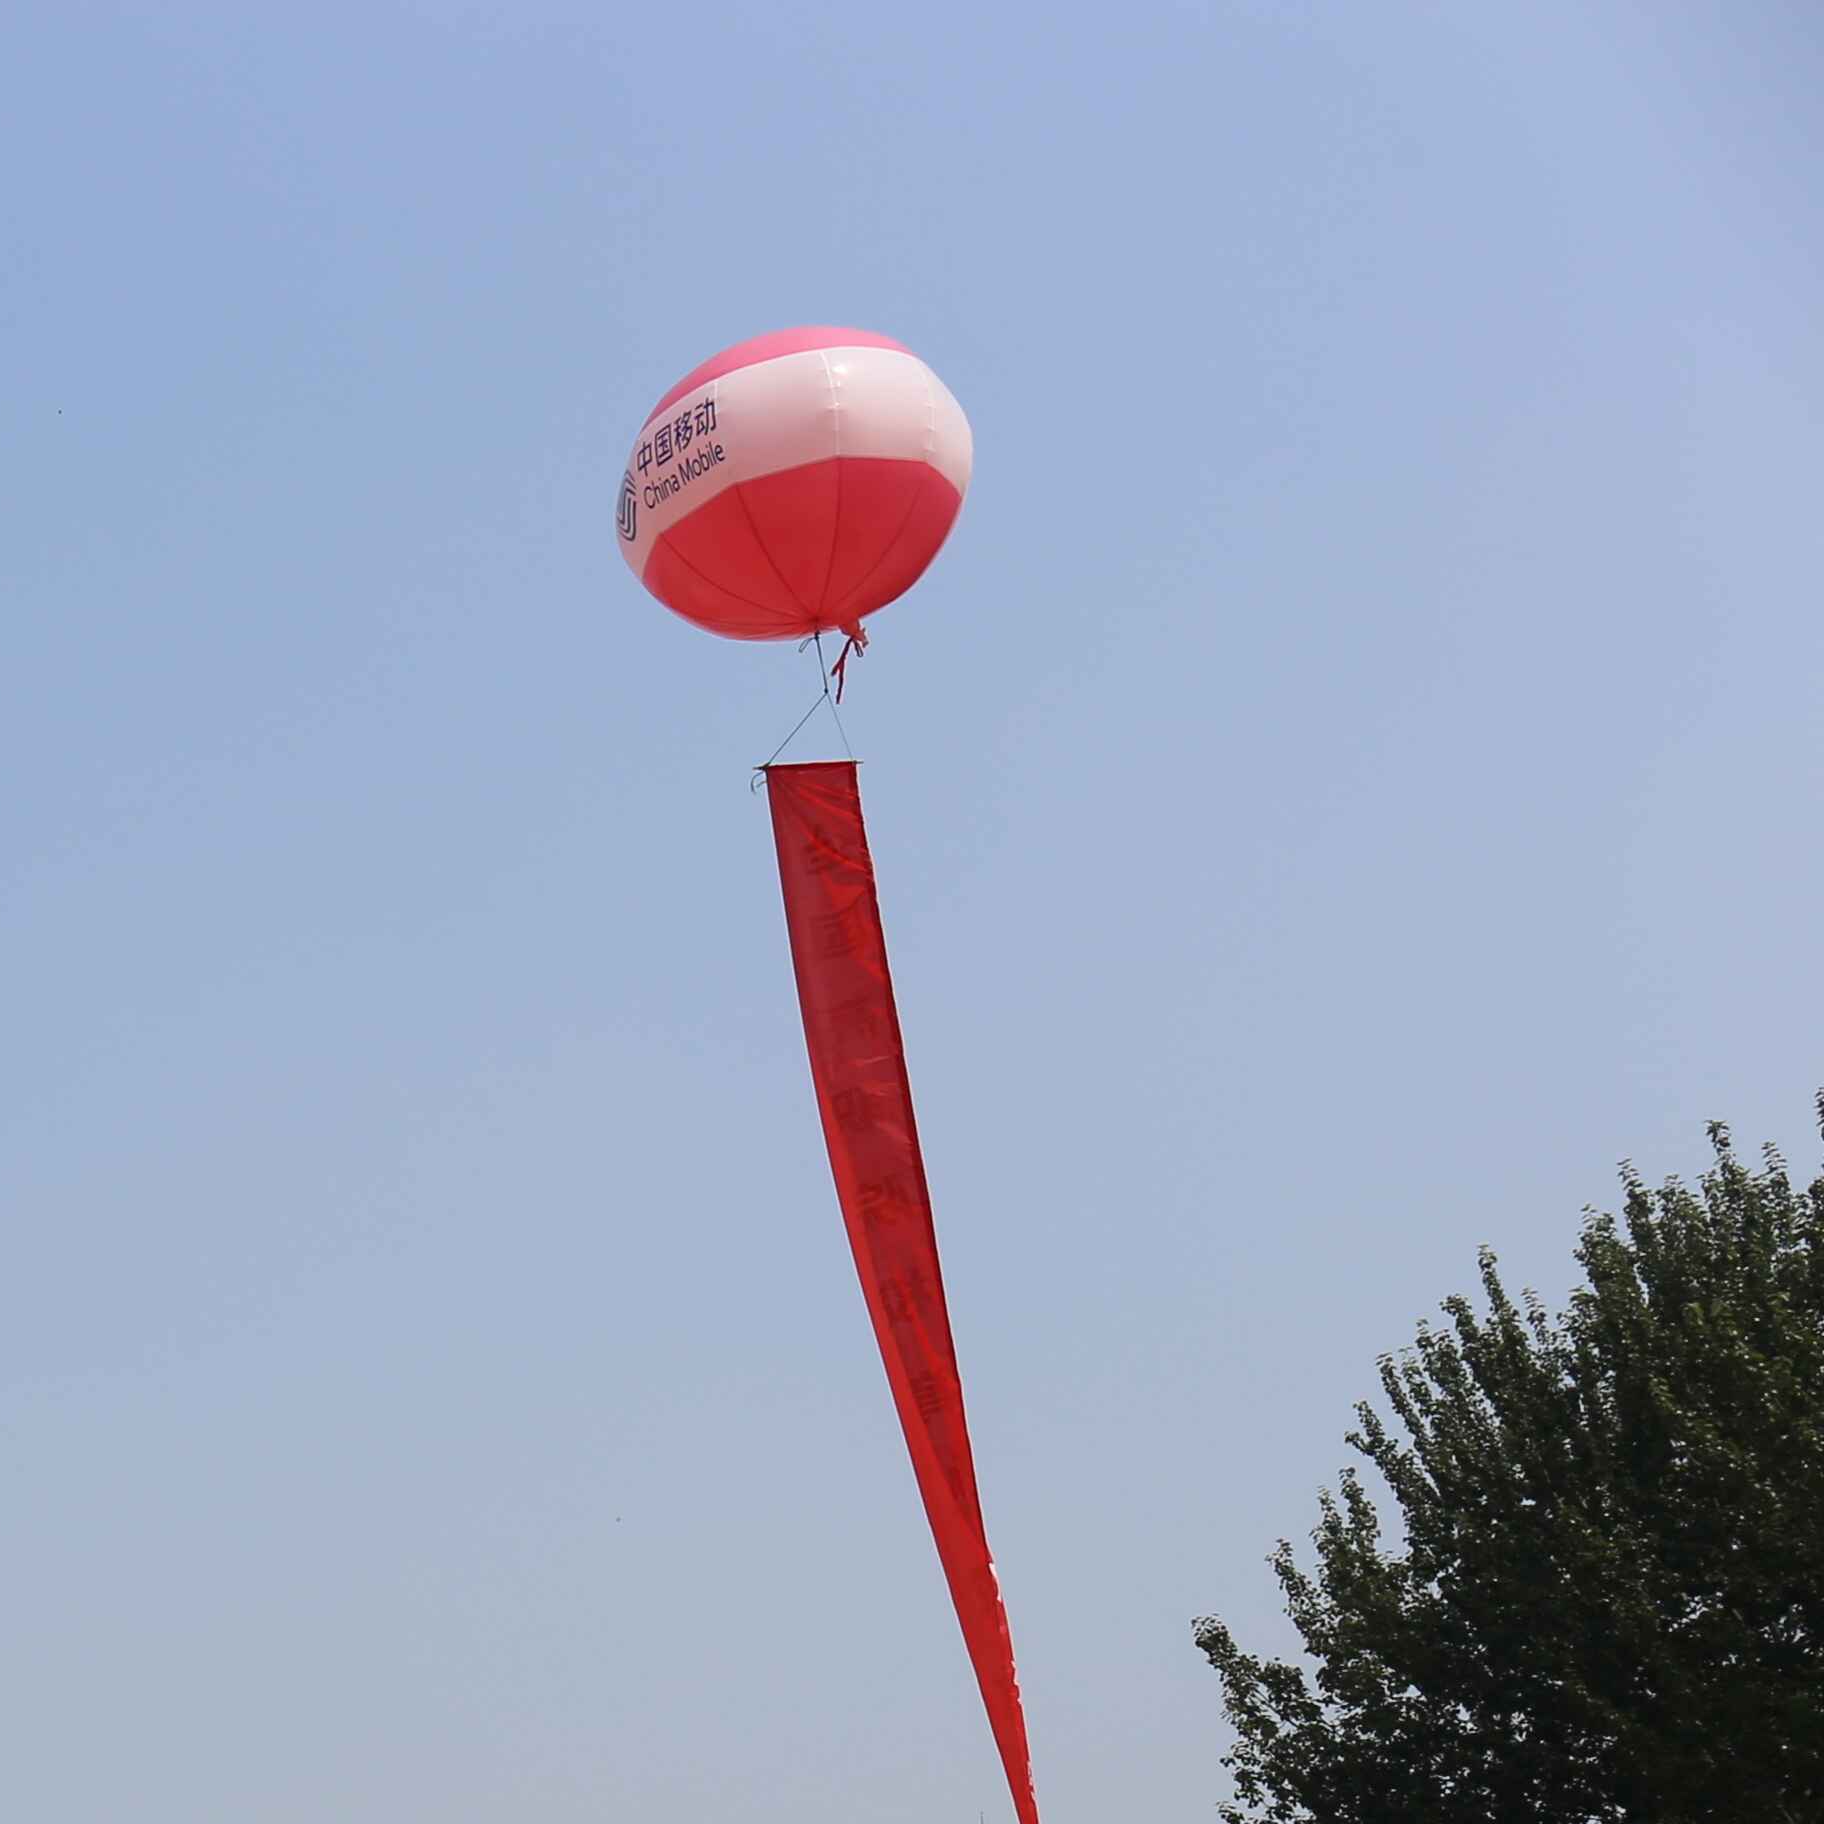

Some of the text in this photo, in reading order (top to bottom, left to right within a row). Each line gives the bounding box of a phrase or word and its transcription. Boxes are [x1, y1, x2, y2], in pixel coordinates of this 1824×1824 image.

[637, 398, 718, 478] 中国移动
[643, 441, 726, 509] China Mobile
